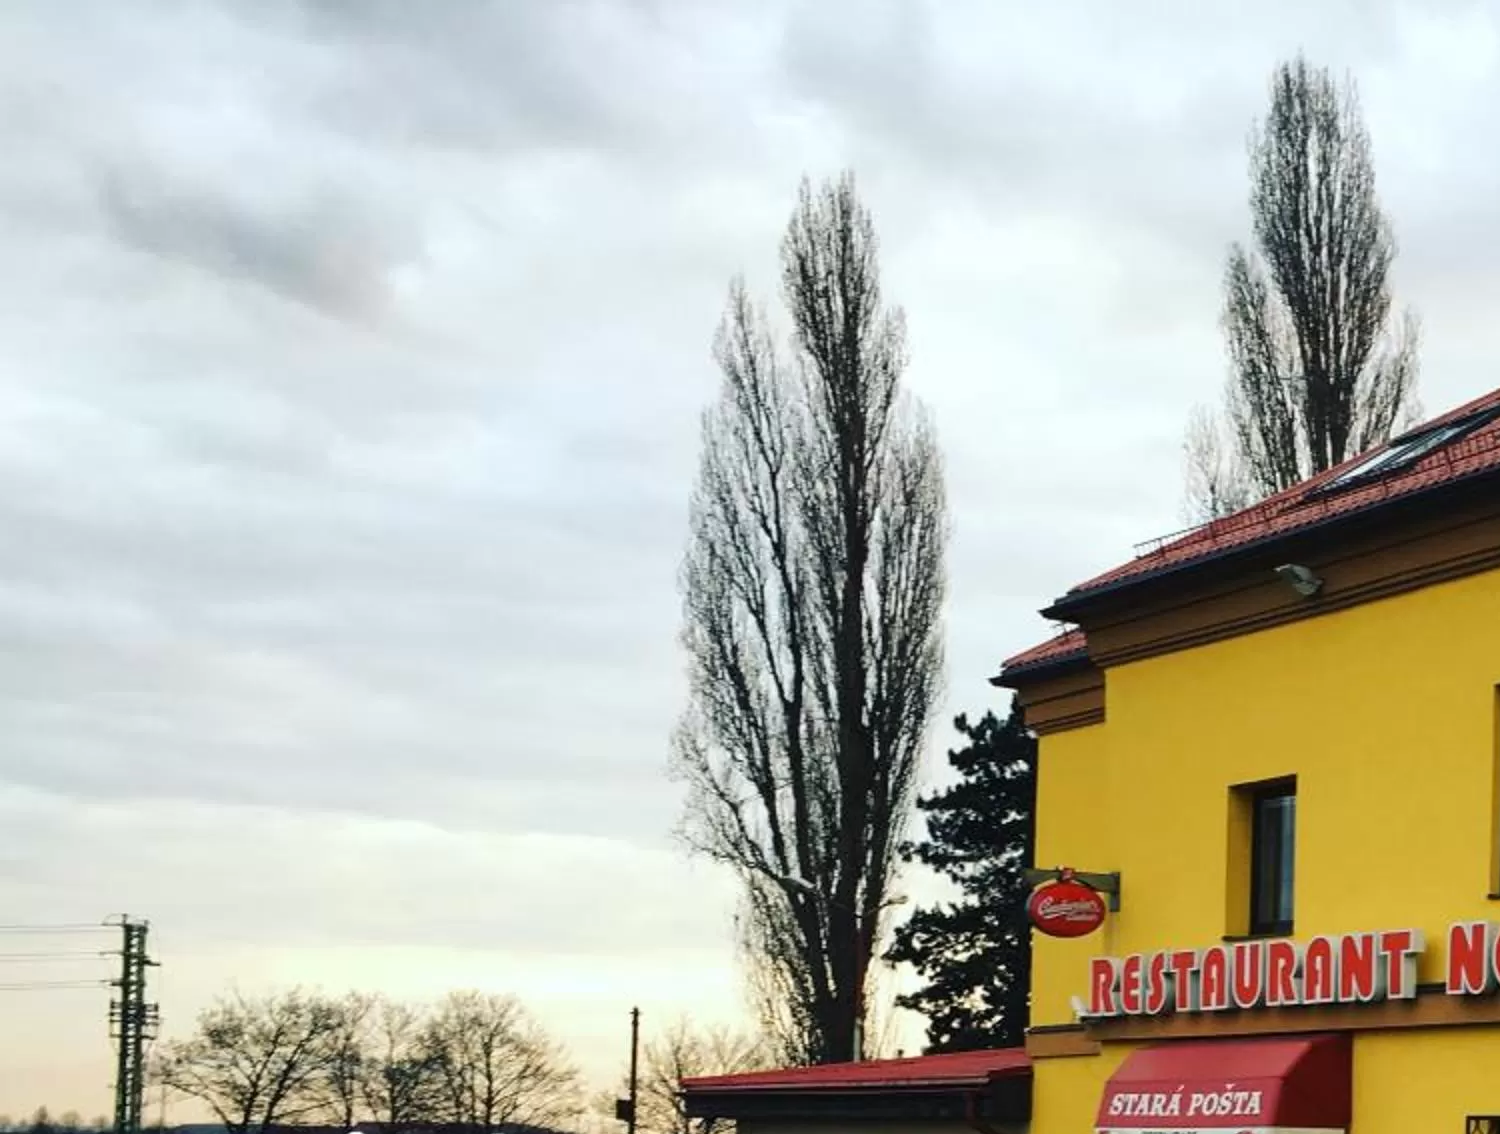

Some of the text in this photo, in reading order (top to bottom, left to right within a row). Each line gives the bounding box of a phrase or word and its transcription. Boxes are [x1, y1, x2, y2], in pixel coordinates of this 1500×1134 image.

[1090, 930, 1420, 1015] RESTAURANT
[1109, 1084, 1262, 1116] STARÁ POŠTA
